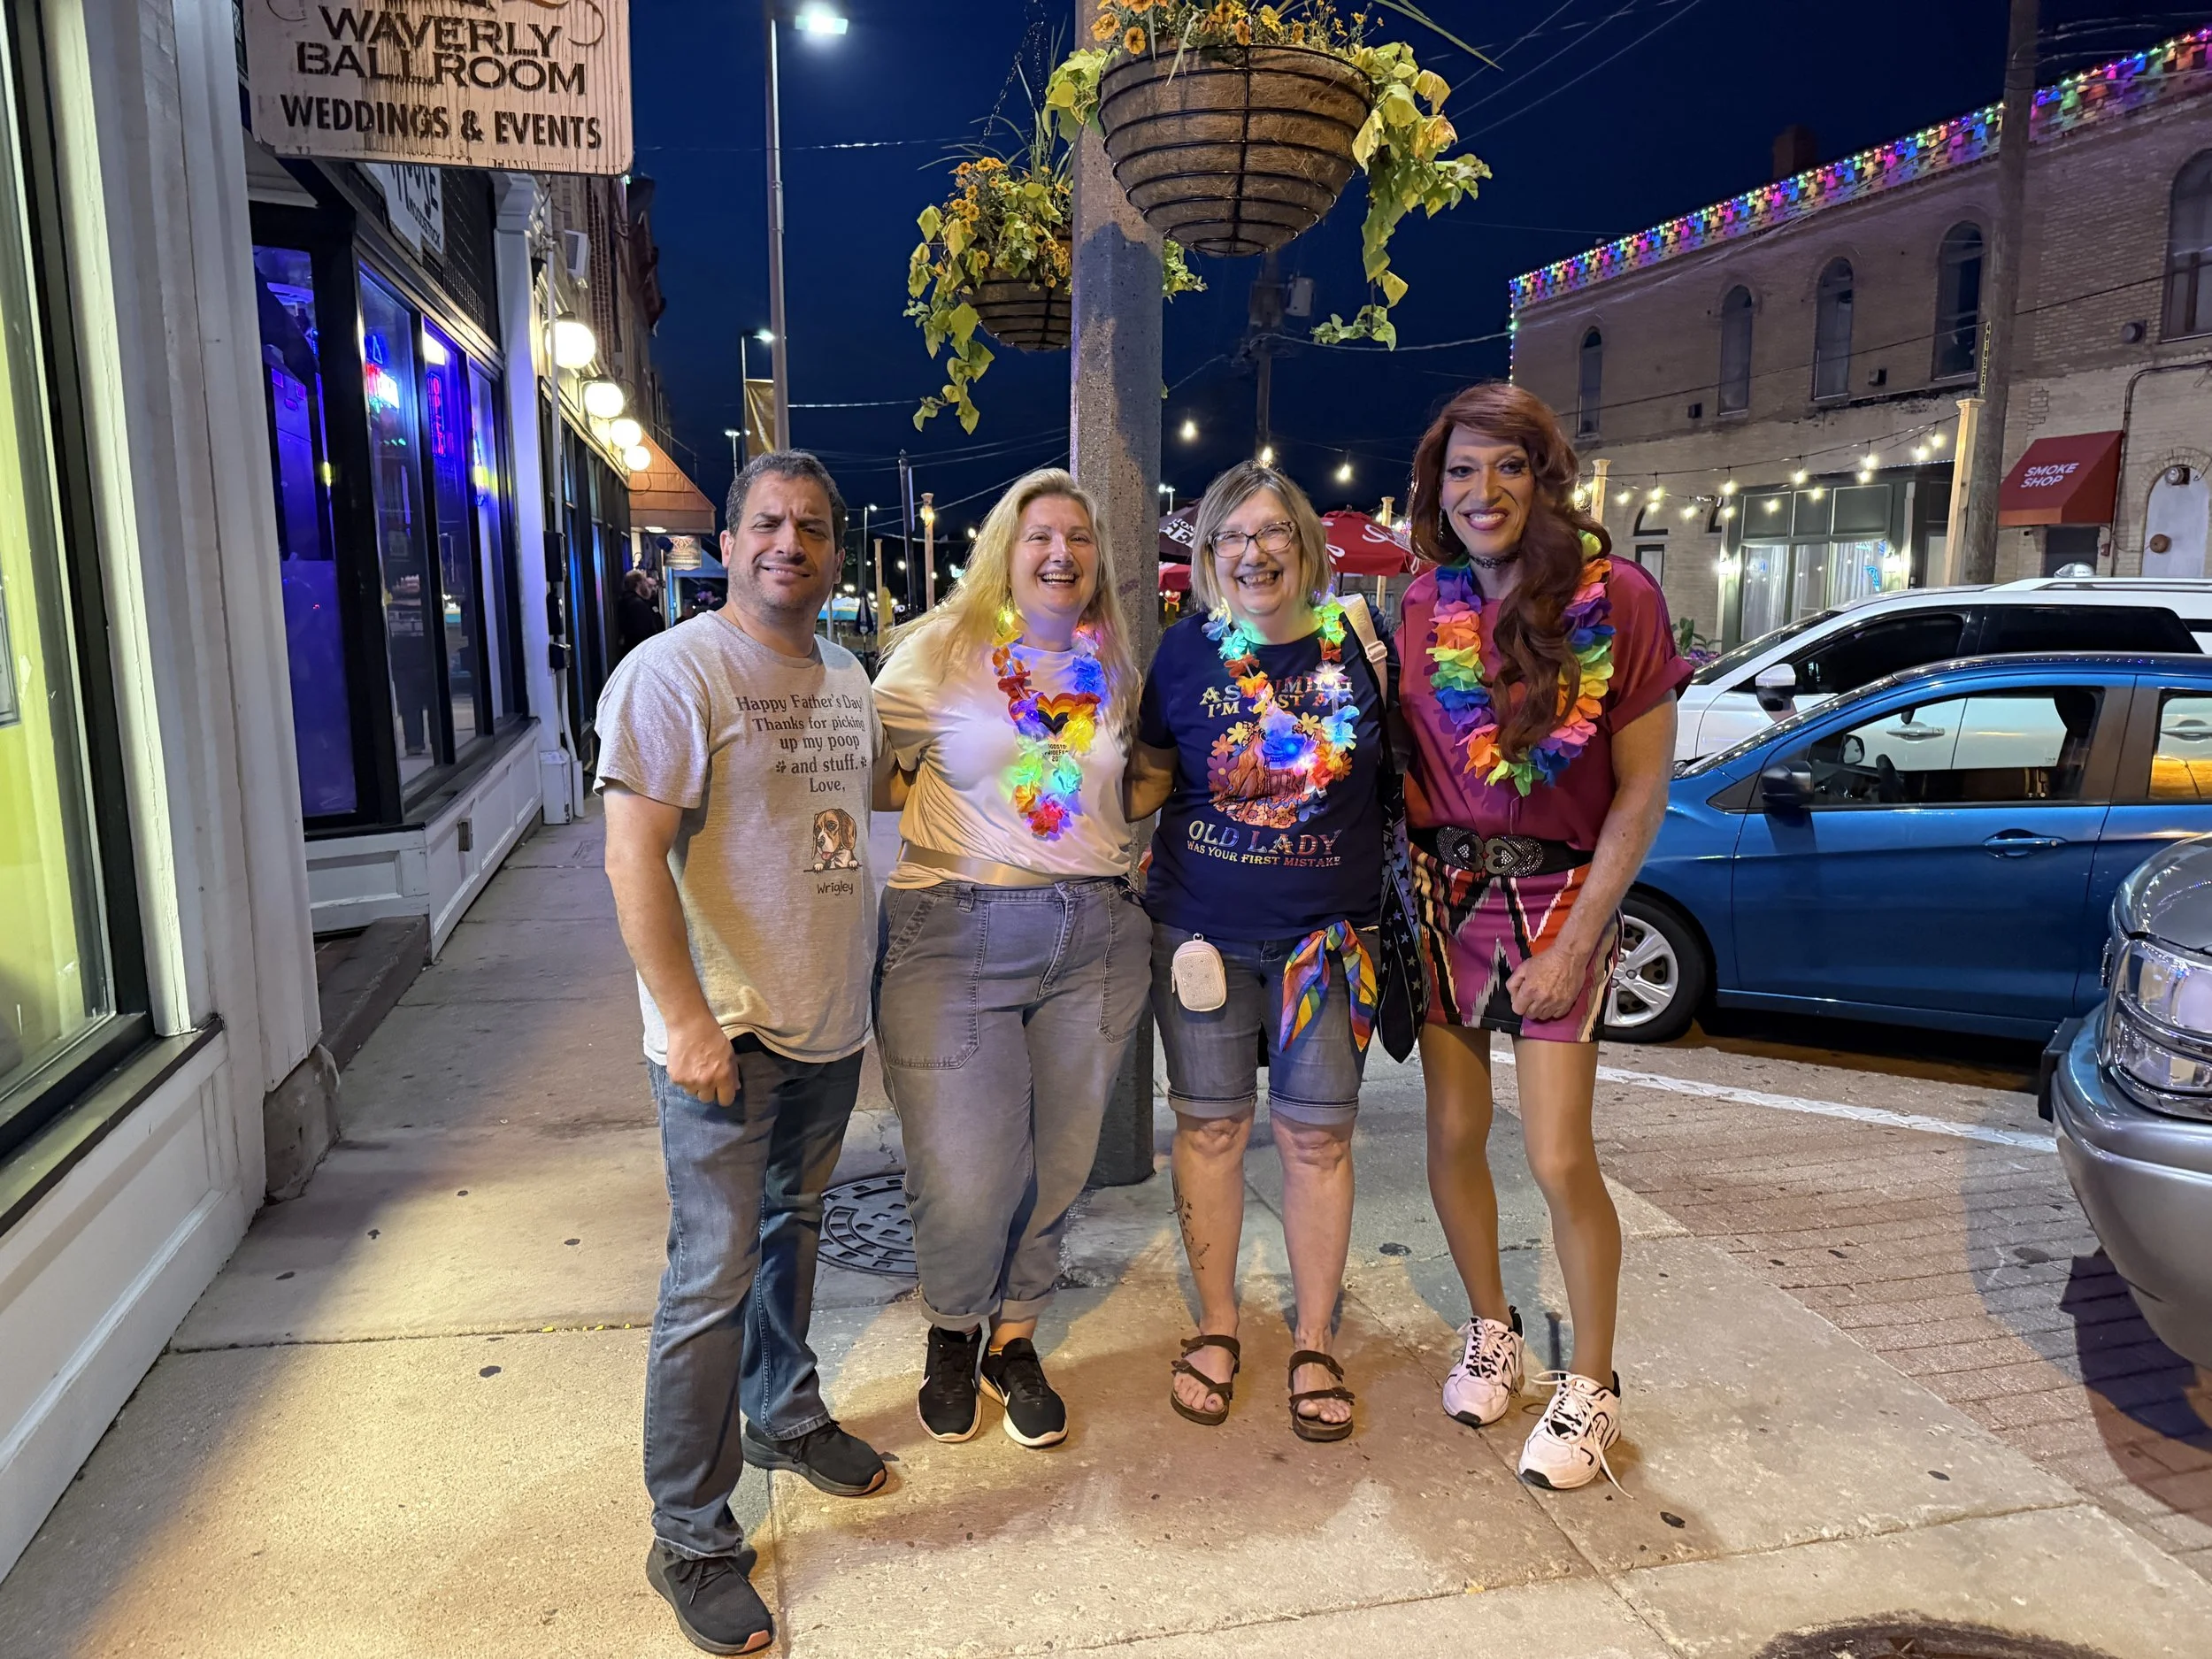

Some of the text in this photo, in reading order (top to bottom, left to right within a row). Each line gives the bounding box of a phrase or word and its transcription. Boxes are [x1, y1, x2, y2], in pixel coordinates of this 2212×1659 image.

[318, 4, 562, 58] WAVERLY
[296, 41, 586, 96] BALLROOM
[280, 94, 602, 150] WEDDINGS & EVENTS
[2024, 463, 2079, 477] SMOKE
[2020, 475, 2064, 488] SHOP
[735, 695, 787, 712] Happy
[790, 694, 841, 710] Father's
[1208, 701, 1240, 718] I'M
[752, 716, 865, 732] Thanks for picking
[780, 734, 860, 752] up my poop
[791, 754, 858, 773] and stuff.
[810, 778, 845, 793] Love,
[1189, 819, 1343, 856] OLD LADY
[1187, 841, 1342, 868] WAS YOUR FIRST MISTAKE
